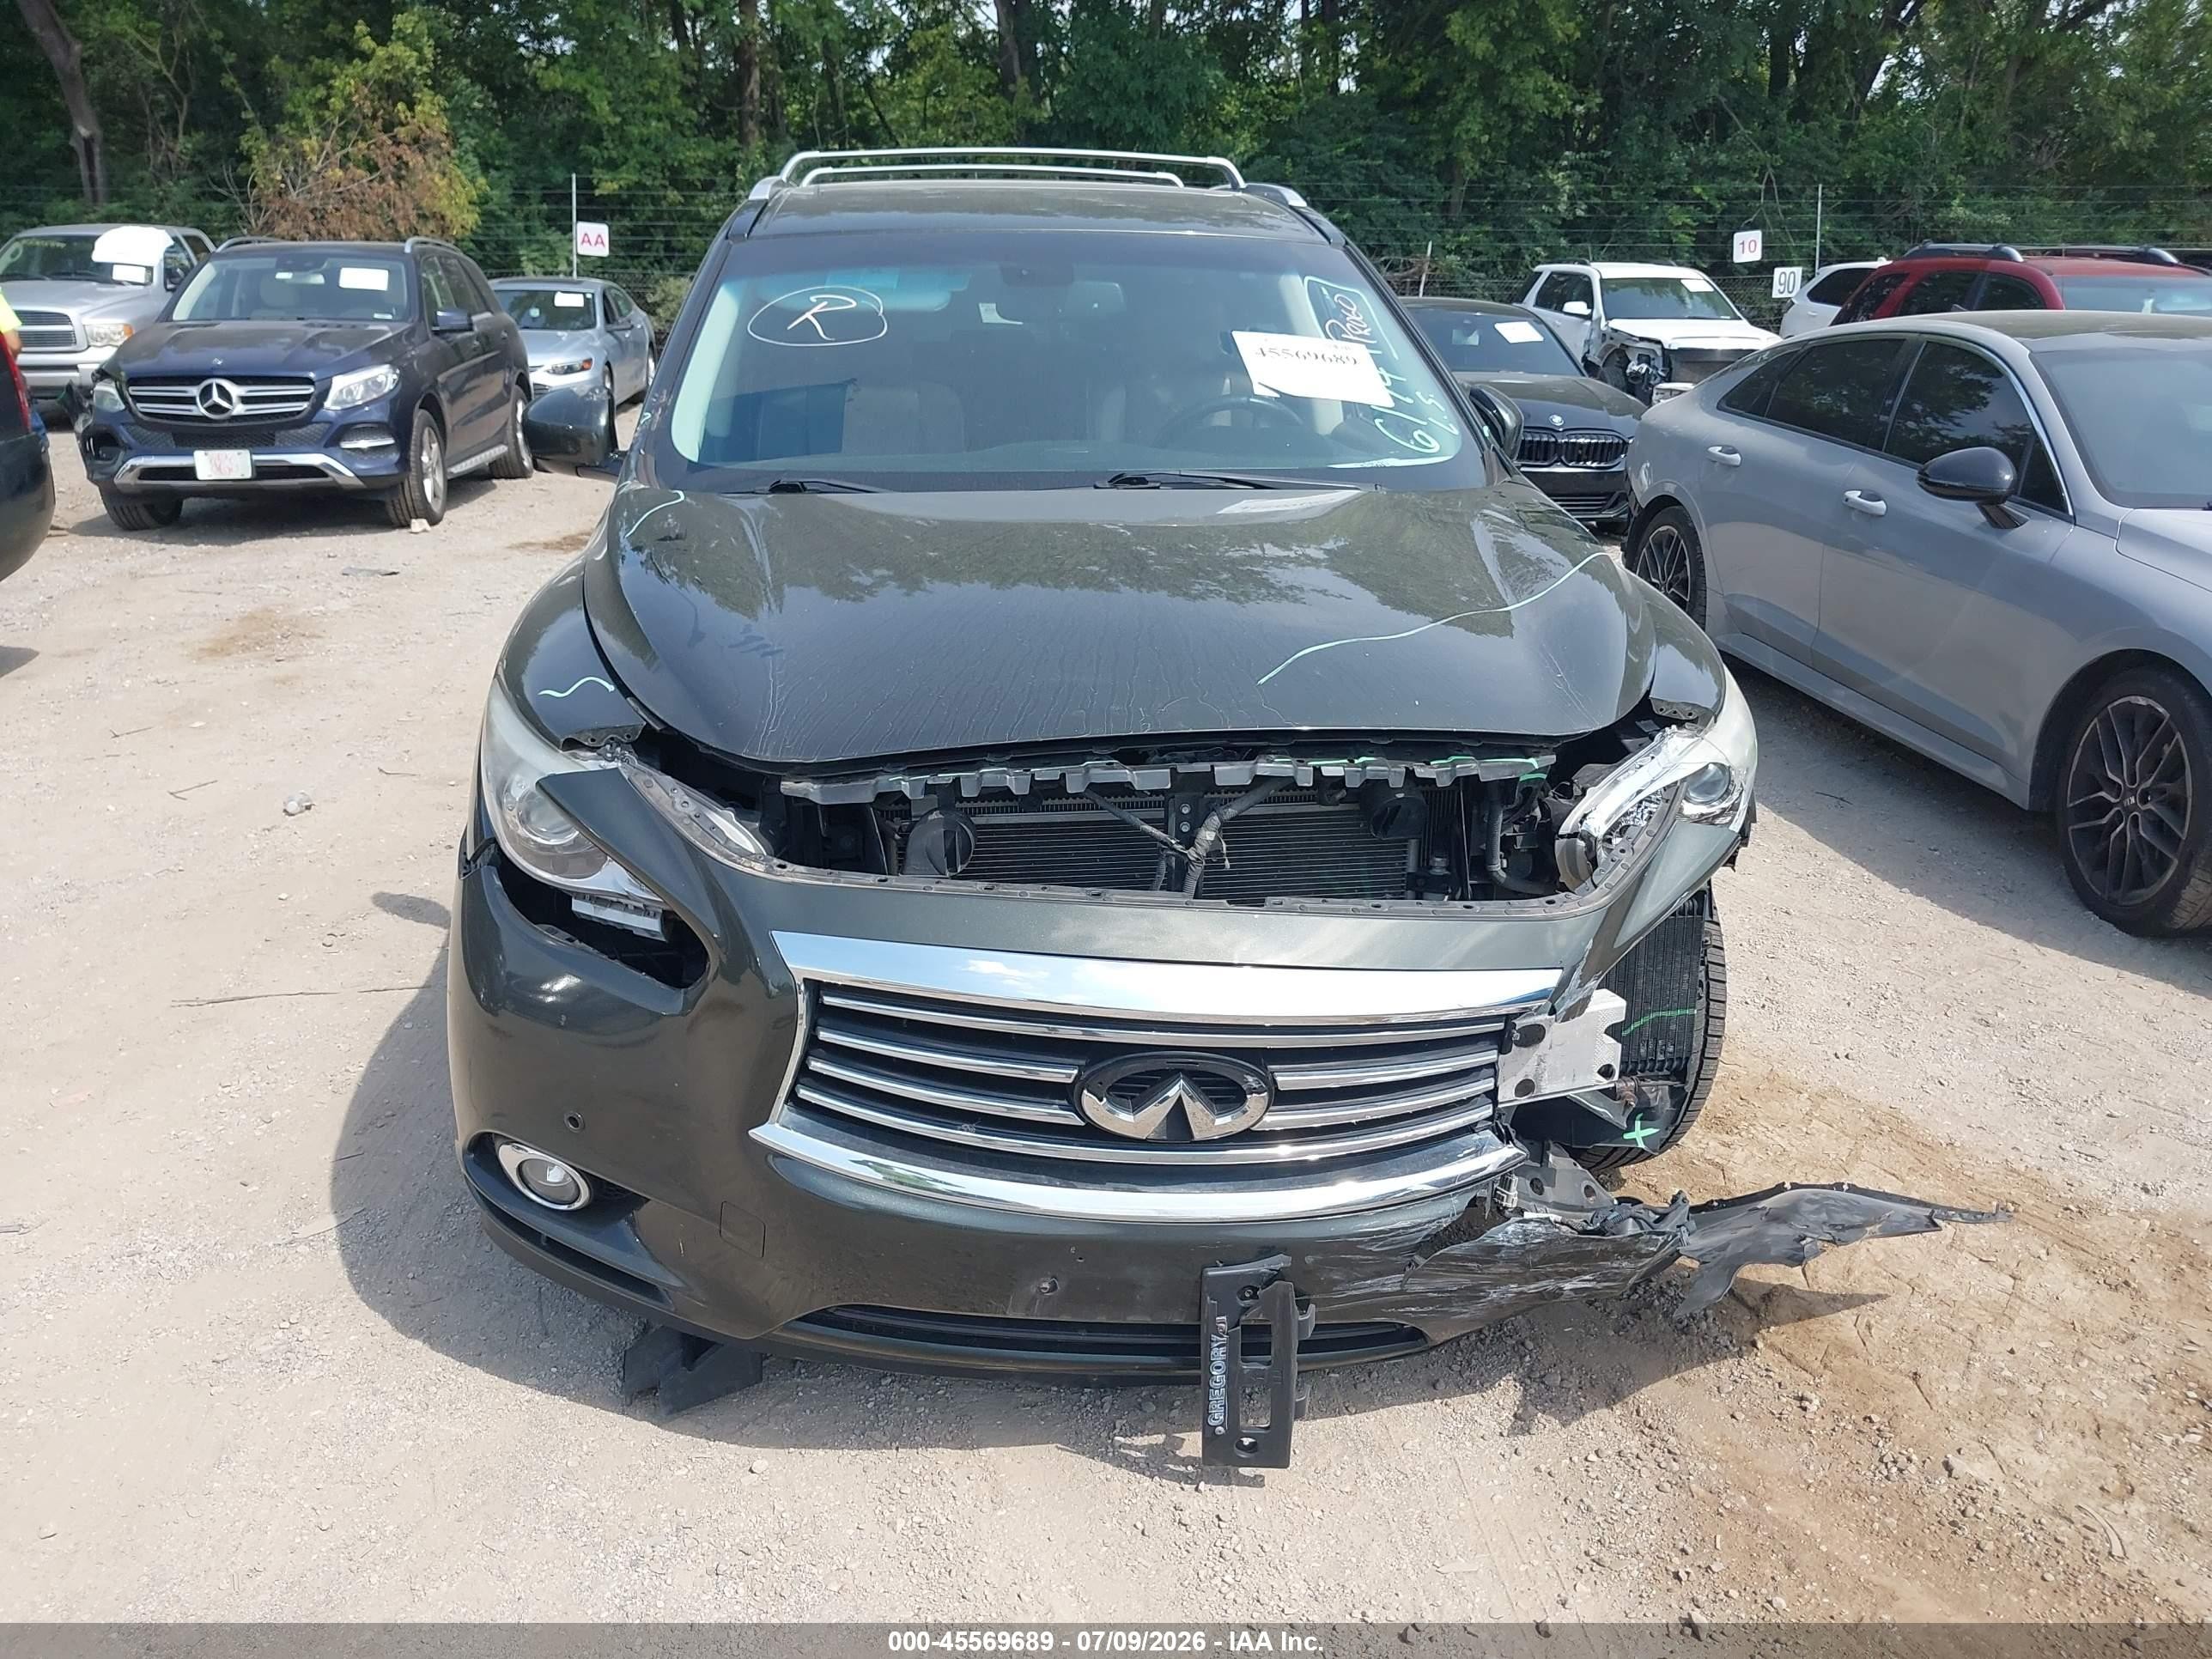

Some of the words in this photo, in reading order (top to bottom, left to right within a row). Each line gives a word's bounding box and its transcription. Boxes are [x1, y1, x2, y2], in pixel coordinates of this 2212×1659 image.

[581, 233, 605, 247] AA
[1739, 239, 1757, 254] 10
[1778, 270, 1796, 295] 90
[787, 295, 858, 341] R
[1207, 1334, 1227, 1427] GREGORY
